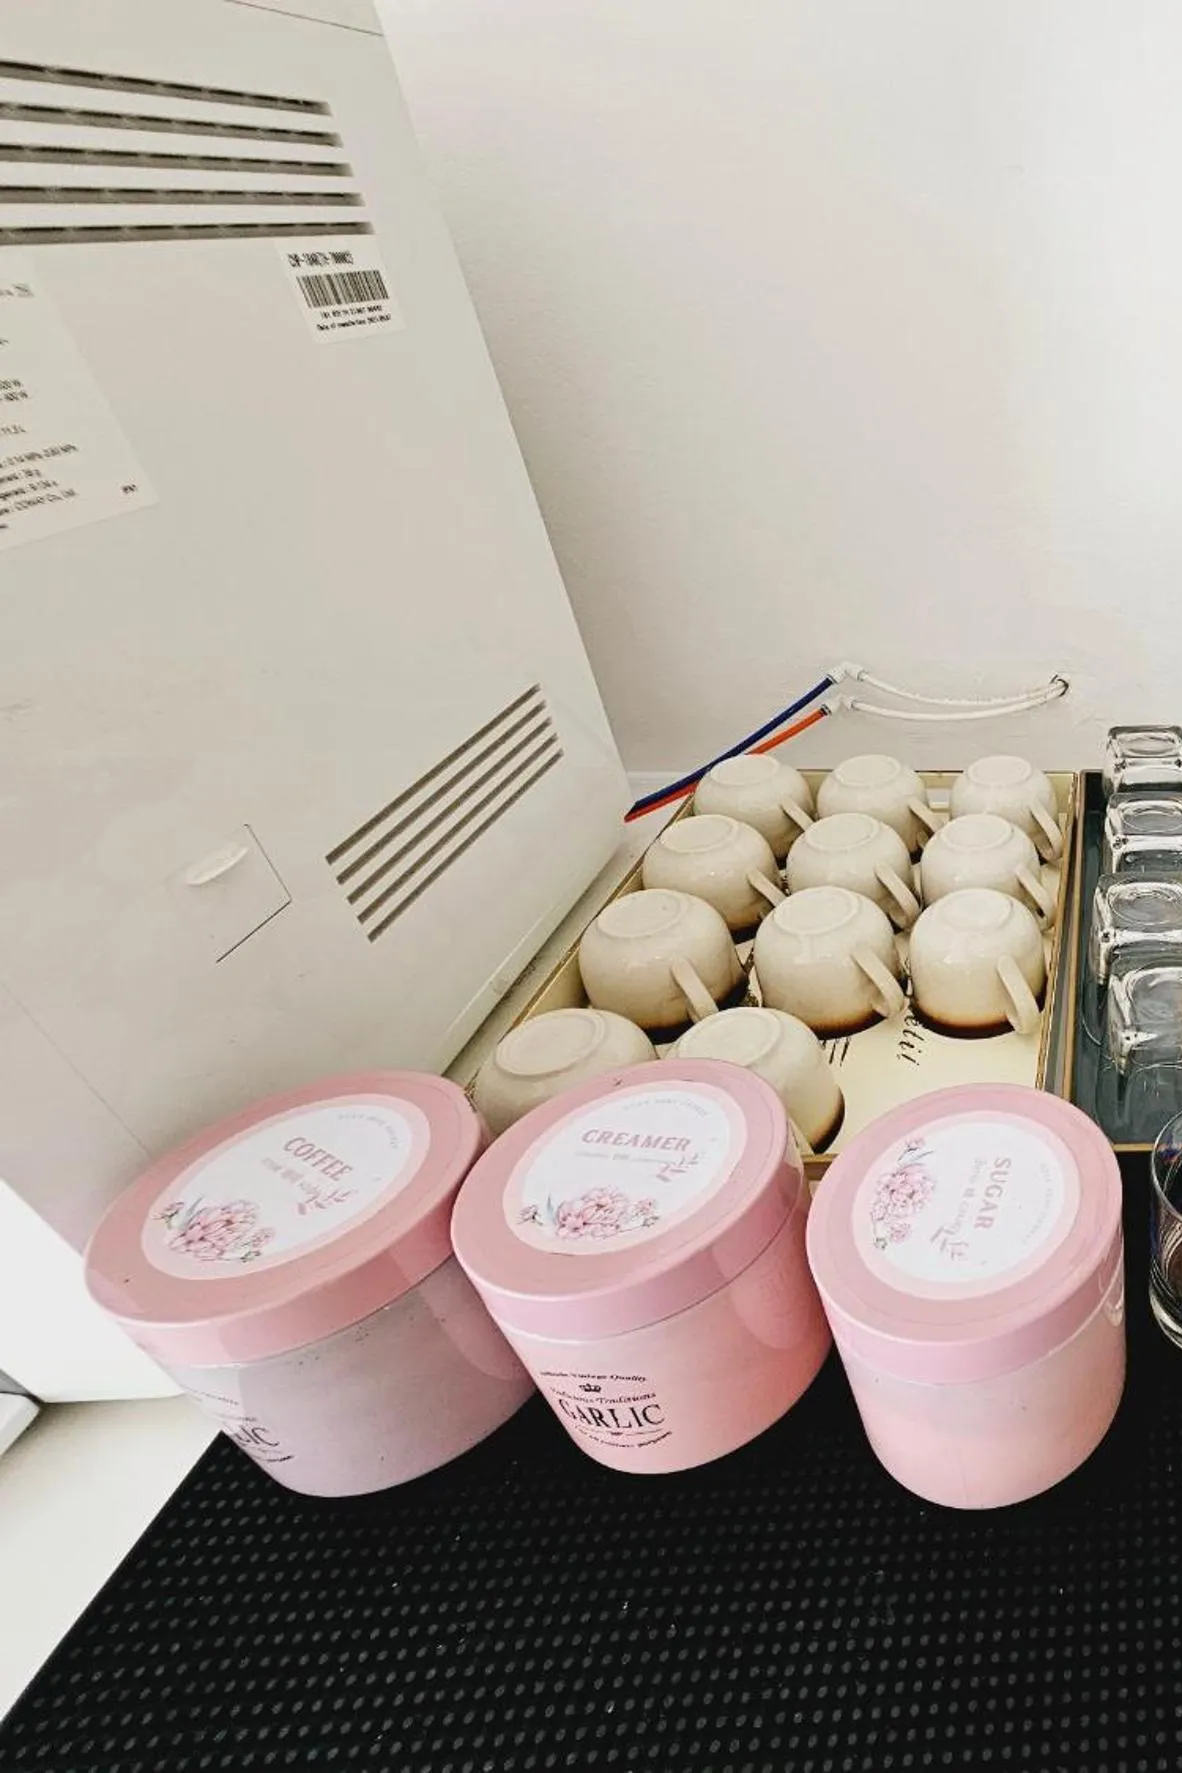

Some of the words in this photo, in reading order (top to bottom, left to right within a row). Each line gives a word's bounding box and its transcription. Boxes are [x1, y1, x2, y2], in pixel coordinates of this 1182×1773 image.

[283, 1136, 354, 1182] COFFEE
[582, 1128, 692, 1152] CREAMER
[973, 1156, 1013, 1231] SUGAR
[558, 1398, 666, 1429] GARLIC
